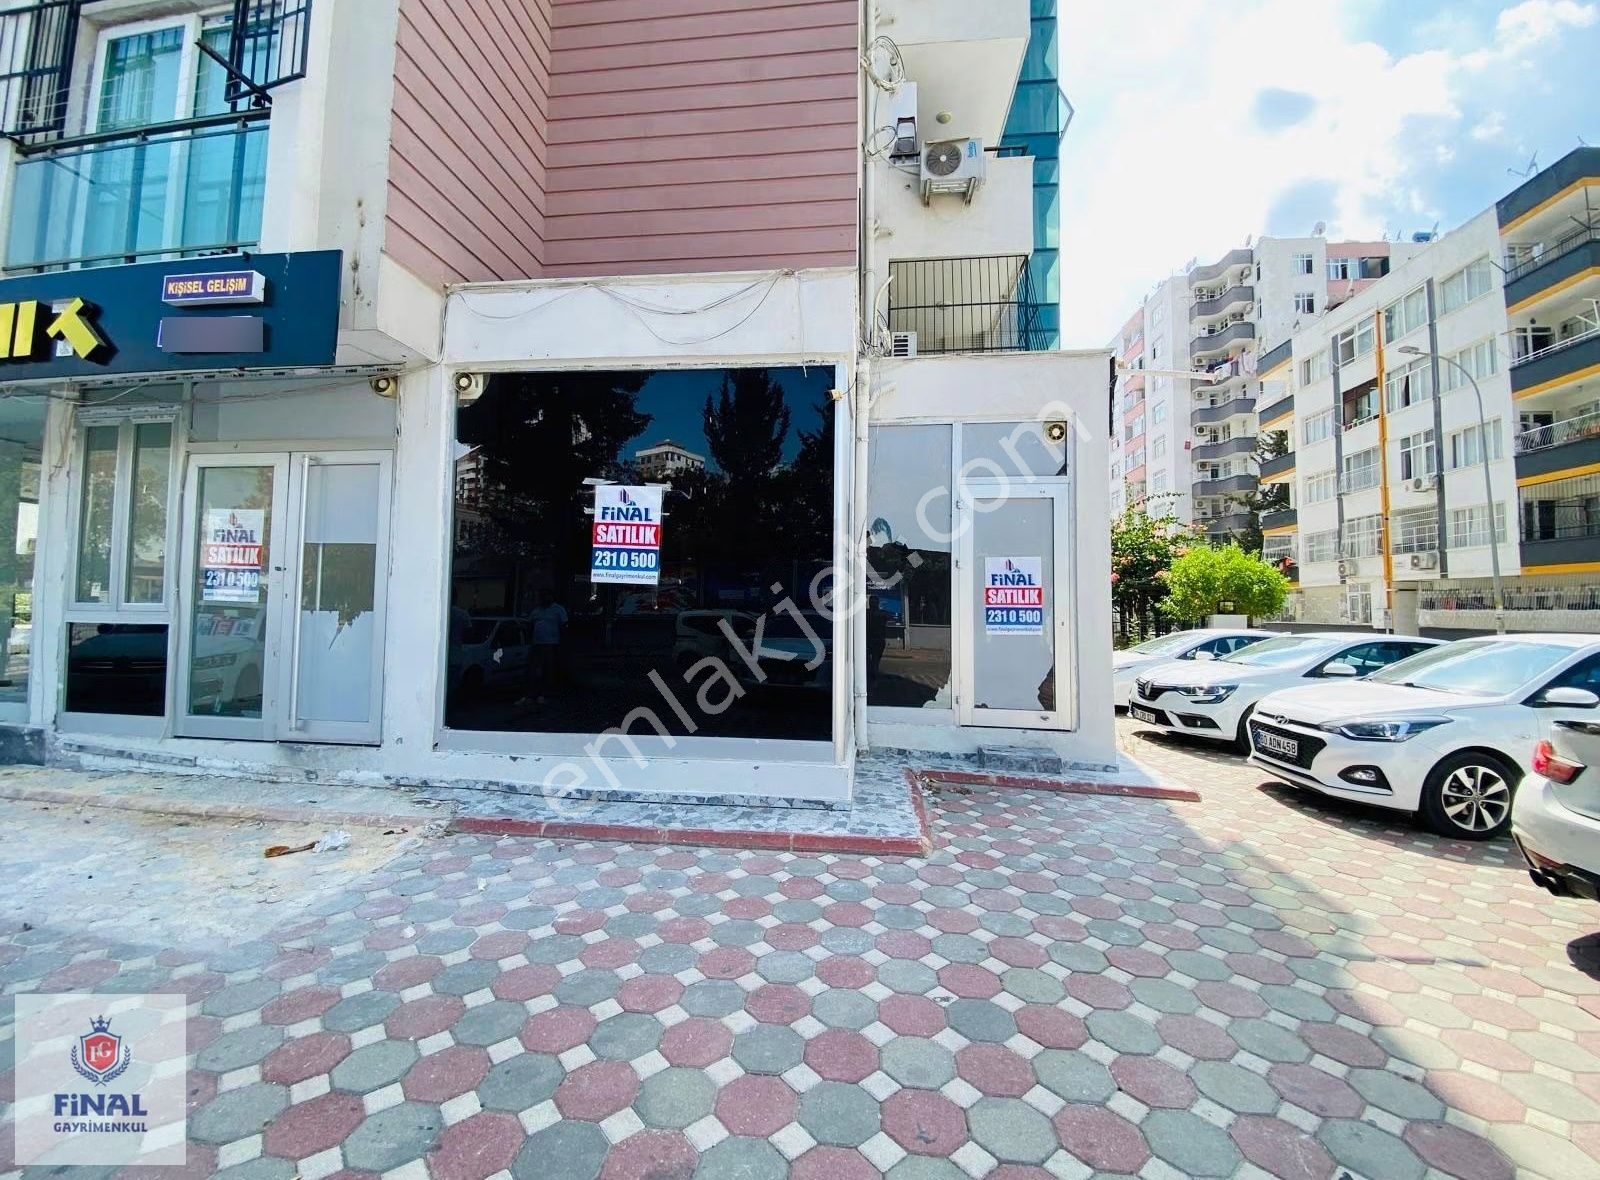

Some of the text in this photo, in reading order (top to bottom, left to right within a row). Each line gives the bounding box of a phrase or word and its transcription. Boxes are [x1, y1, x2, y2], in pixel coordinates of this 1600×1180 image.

[596, 525, 657, 545] SATILIK
[208, 546, 259, 565] SATILIK
[594, 550, 656, 568] 231 0 500
[206, 570, 226, 587] 231
[237, 571, 259, 588] 500
[987, 588, 1040, 605] SATILIK
[987, 609, 1041, 623] 231 0 500
